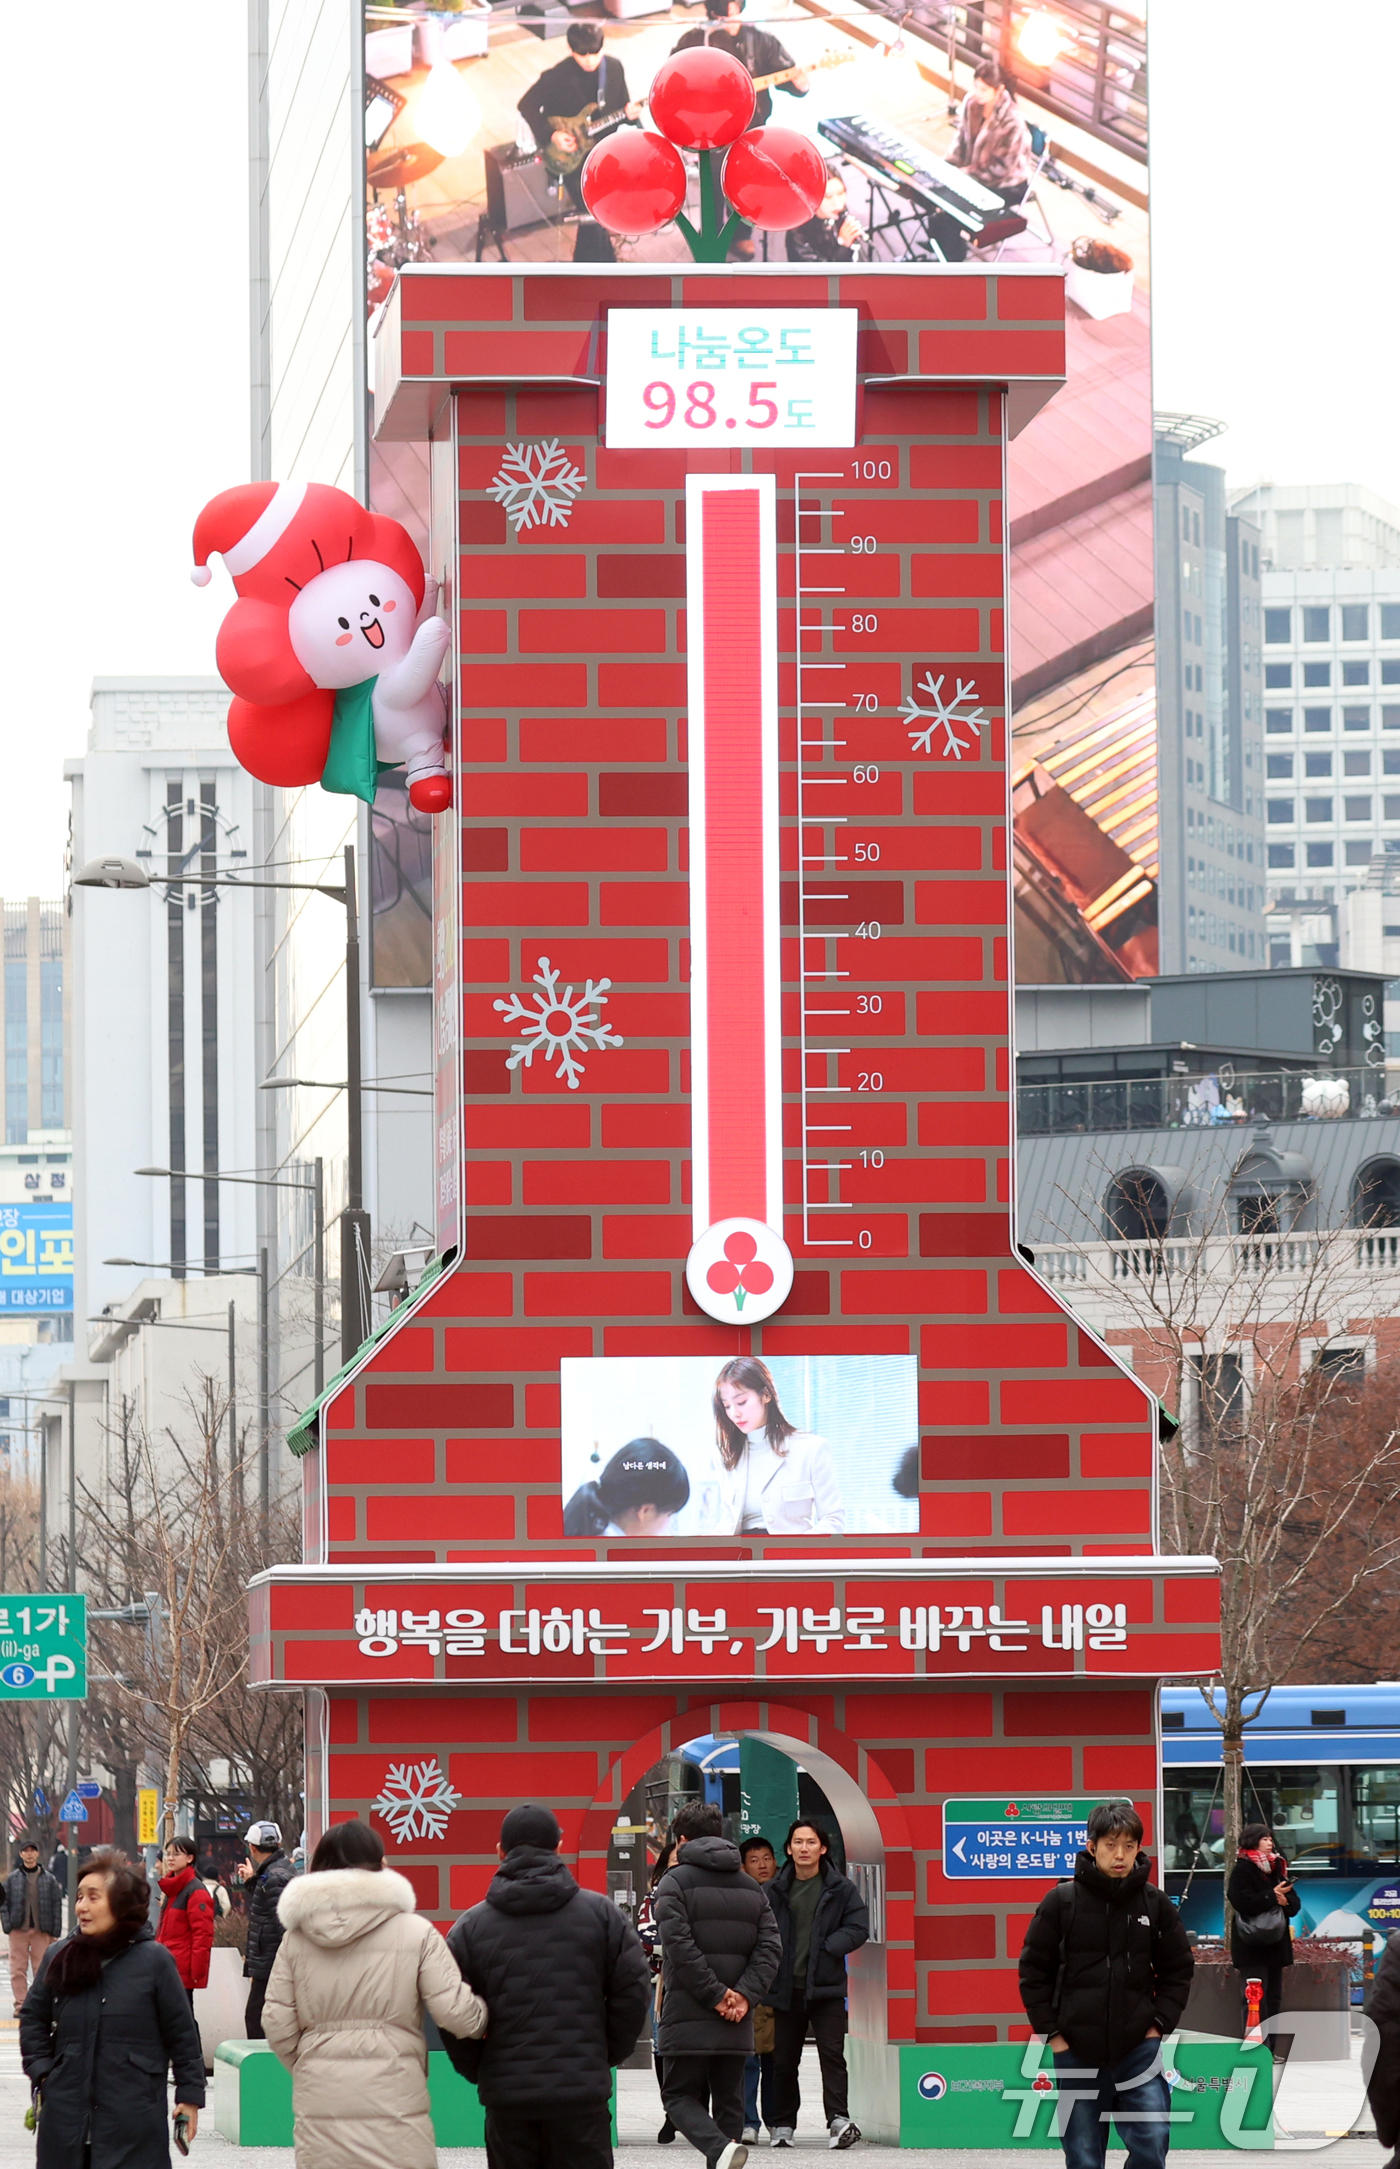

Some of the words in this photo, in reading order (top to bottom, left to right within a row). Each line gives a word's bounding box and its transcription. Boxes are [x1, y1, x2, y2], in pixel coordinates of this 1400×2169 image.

[651, 325, 815, 370] 나눔온도
[851, 460, 892, 480] 100
[850, 536, 877, 555] 90
[851, 614, 878, 633] 80
[852, 694, 879, 713] 70
[852, 765, 879, 784] 60
[854, 843, 880, 862] 50
[855, 921, 881, 940] 40
[856, 996, 883, 1014] 30
[857, 1072, 884, 1091] 20
[859, 1150, 885, 1169] 10
[858, 1230, 872, 1249] 0
[11, 1288, 65, 1305] 대상기업
[354, 1608, 488, 1657] 행복을
[499, 1607, 630, 1655] 더하는
[641, 1607, 743, 1655] 기부,
[755, 1606, 888, 1654] 기부로
[899, 1605, 1030, 1652] 바꾸는
[1041, 1603, 1128, 1651] 내일
[12, 1666, 25, 1685] 6
[977, 1830, 1018, 1847] 이곳은
[1021, 1830, 1063, 1847] K-나눔
[1181, 2075, 1249, 2094] 서울특별시
